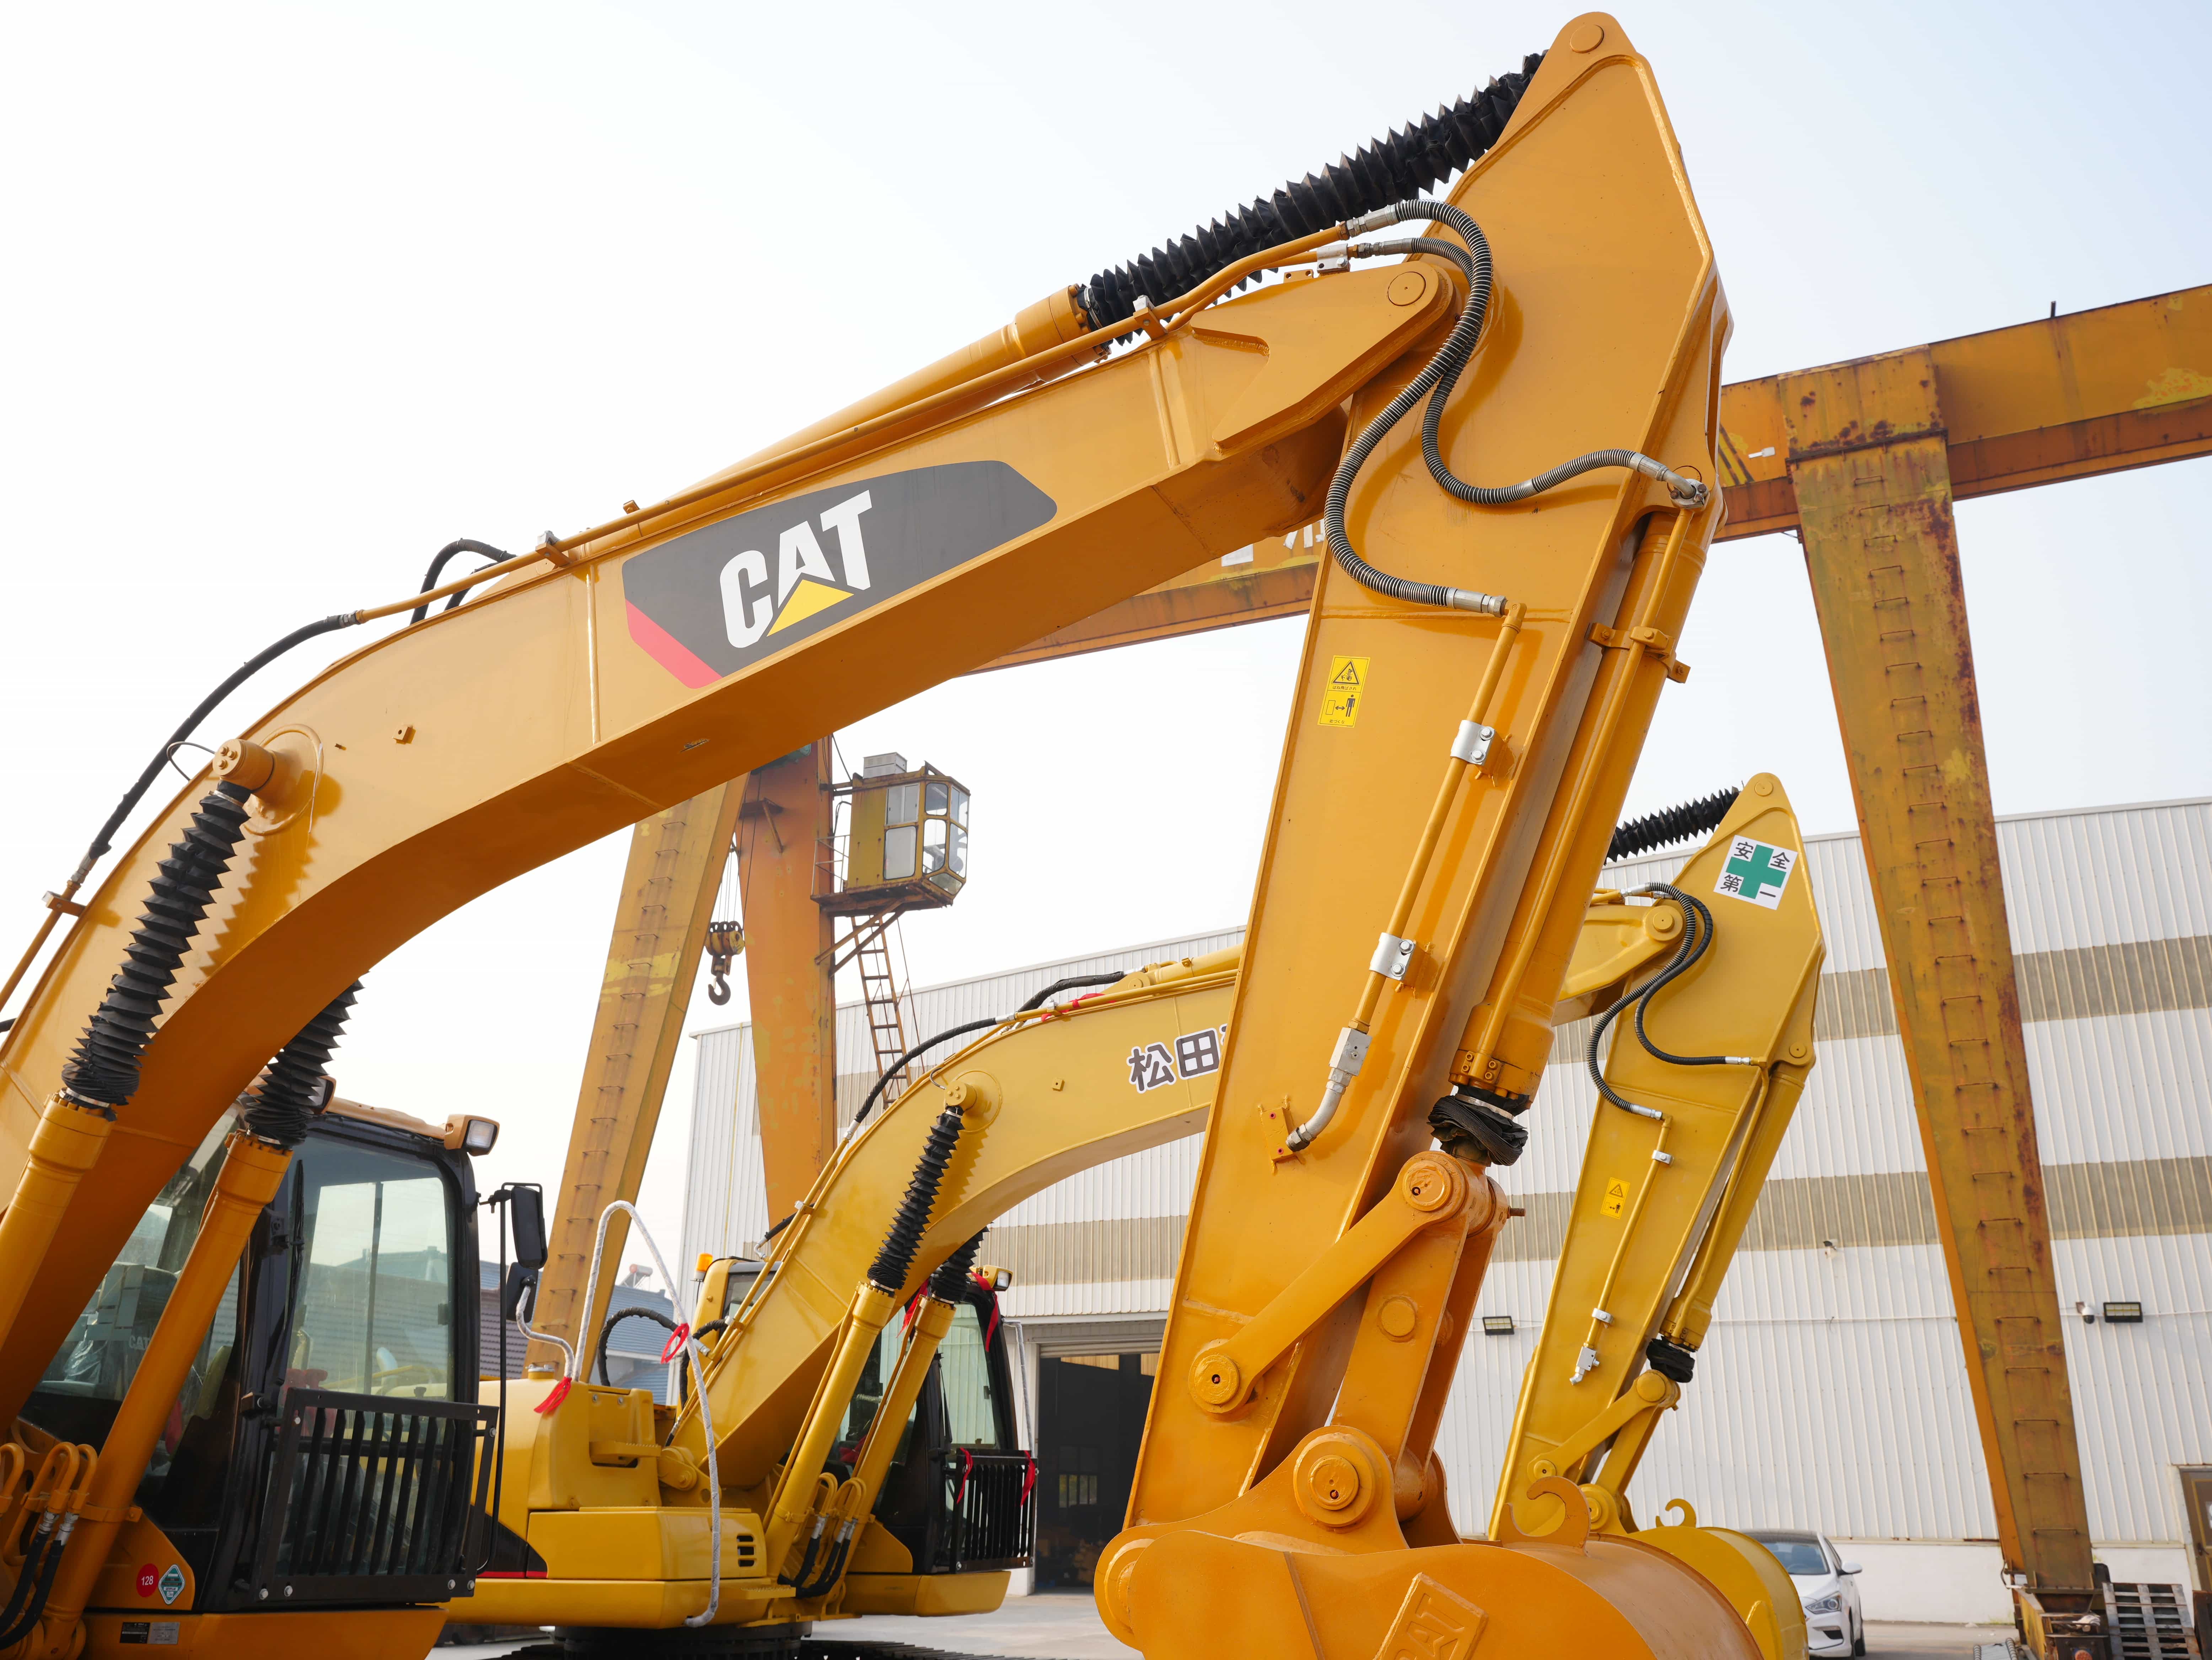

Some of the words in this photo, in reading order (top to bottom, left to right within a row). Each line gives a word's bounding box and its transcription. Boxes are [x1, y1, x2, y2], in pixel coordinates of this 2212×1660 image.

[720, 490, 873, 648] CAT
[1128, 1024, 1227, 1092] 松田
[129, 1335, 150, 1350] CAT
[141, 1575, 154, 1586] 128
[1394, 1593, 1465, 1660] AT
